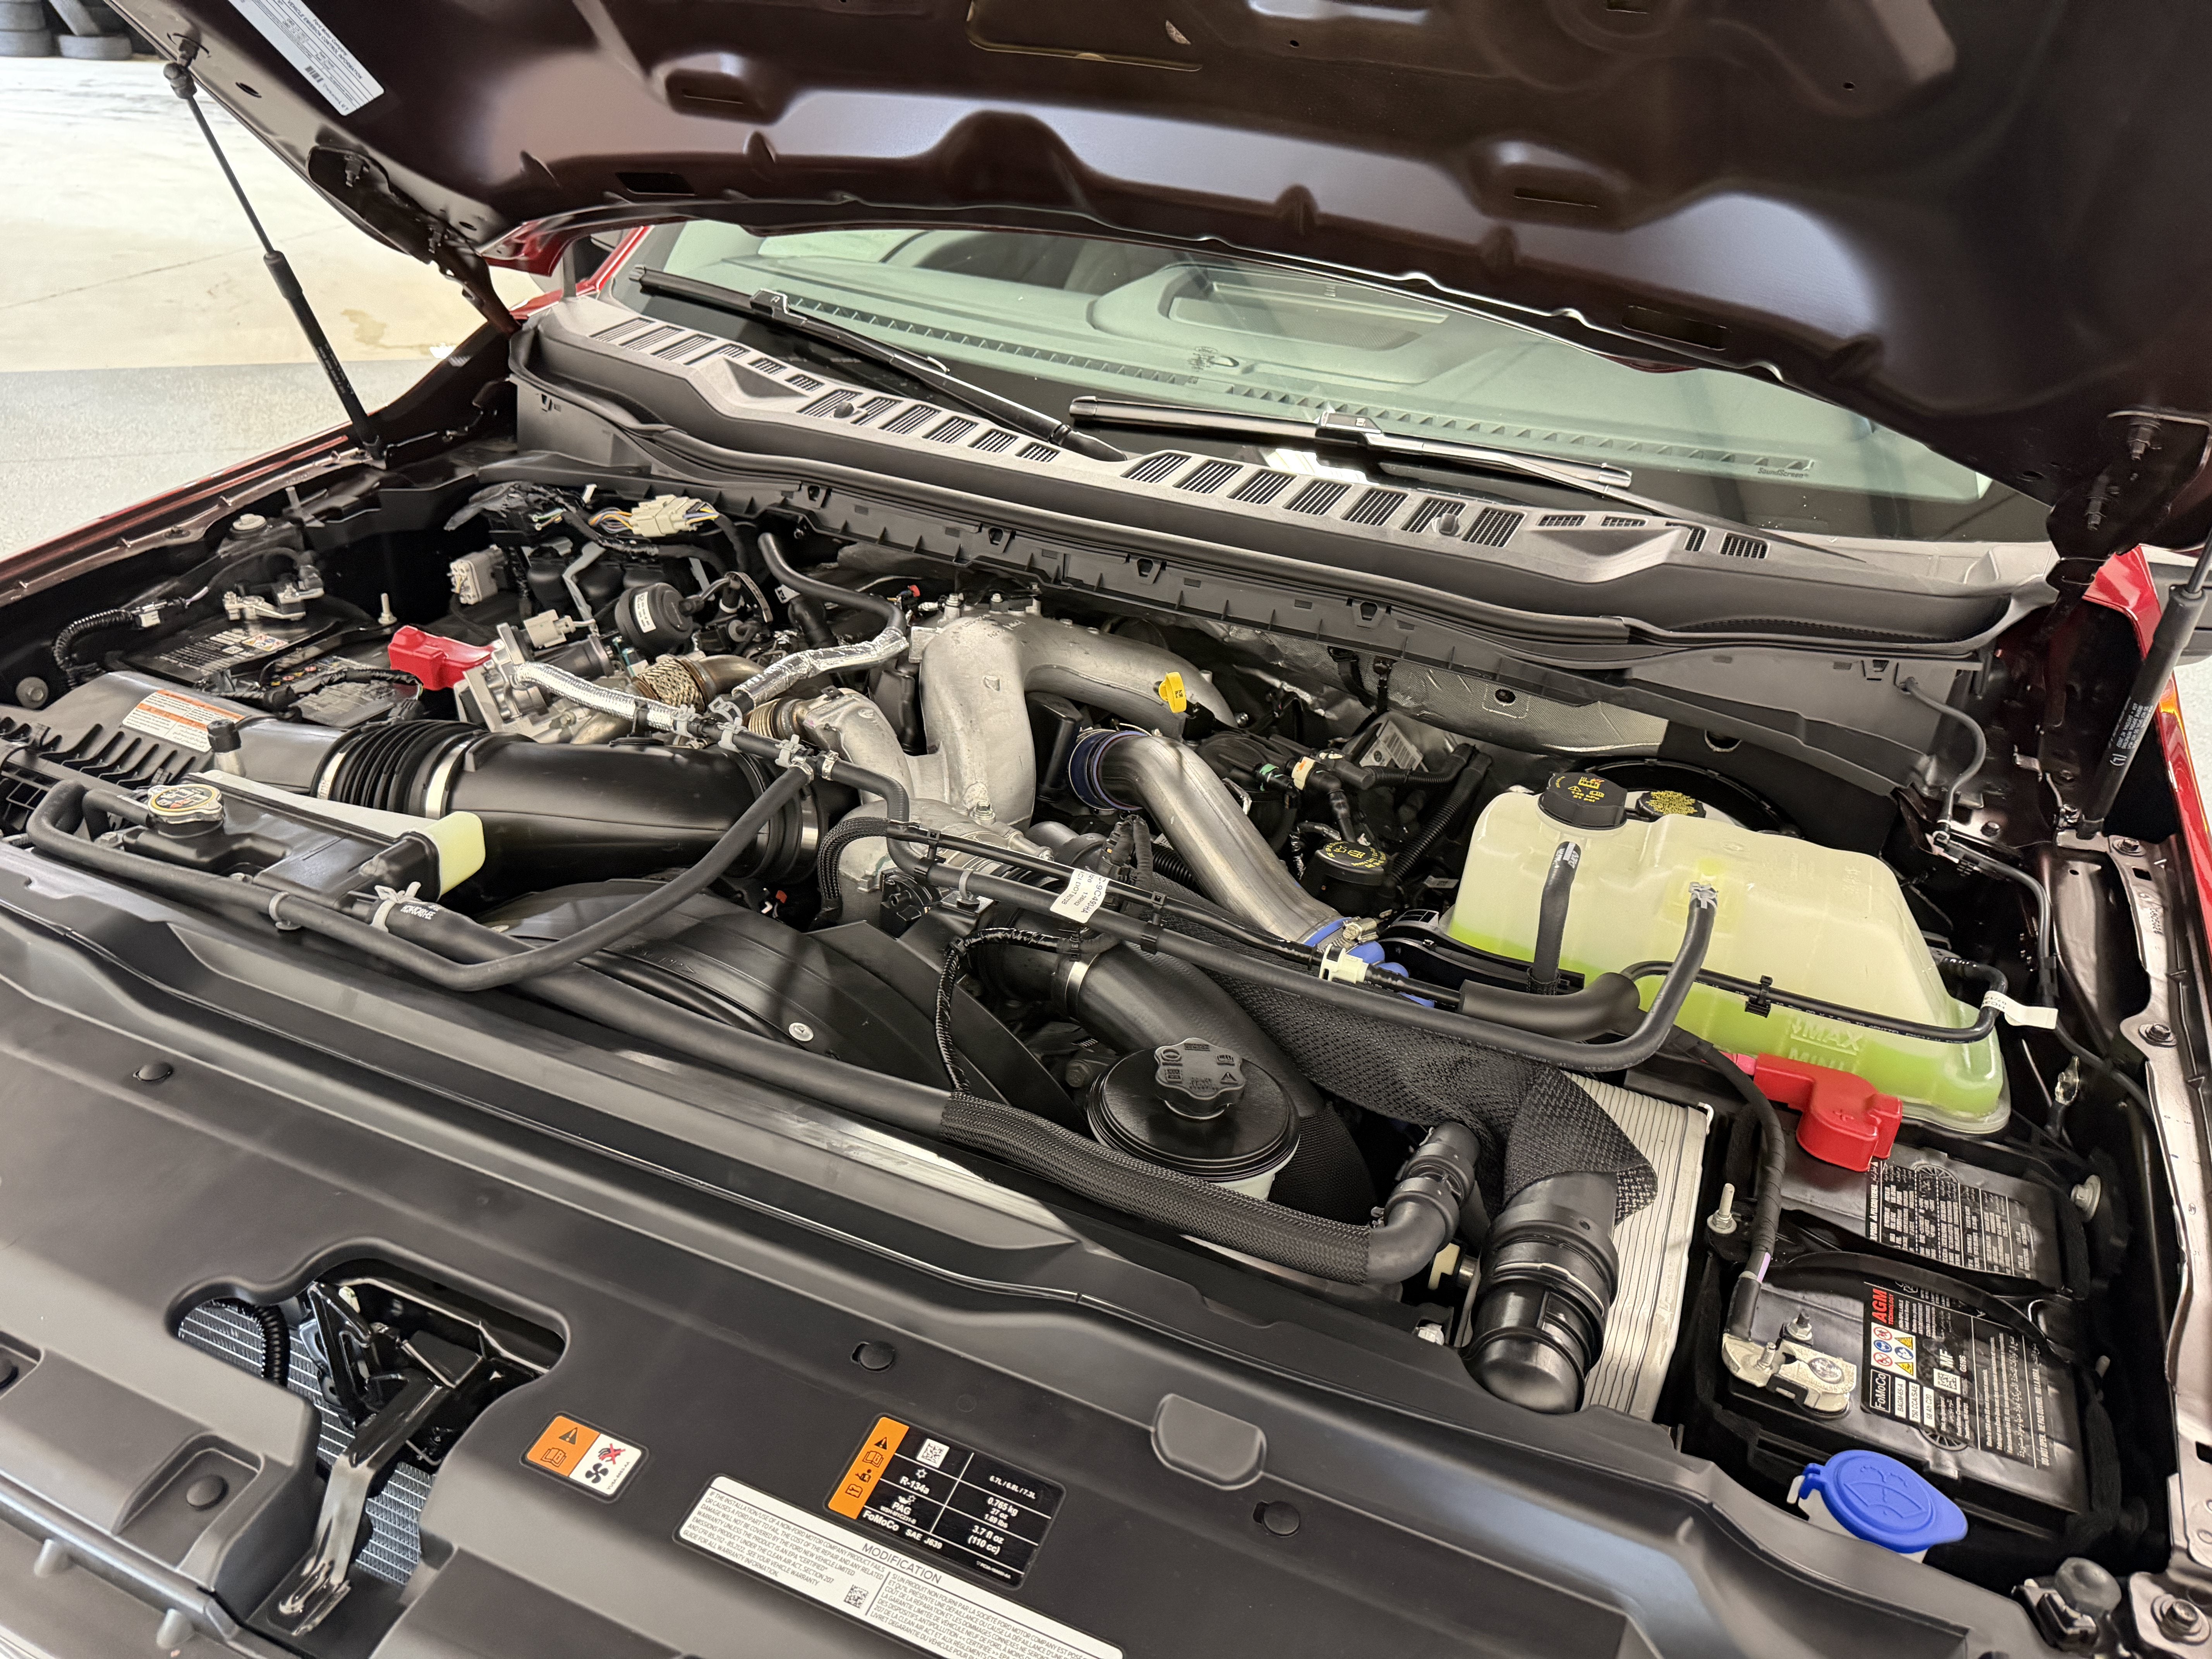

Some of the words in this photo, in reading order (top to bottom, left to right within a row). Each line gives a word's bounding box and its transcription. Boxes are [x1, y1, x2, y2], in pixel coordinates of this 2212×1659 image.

[1871, 1288, 1887, 1324] AGM
[1939, 1348, 1953, 1368] MF
[1874, 1372, 1887, 1410] FoMoCo
[1925, 1405, 1932, 1413] Ah
[899, 1475, 931, 1495] R-134a
[989, 1475, 1004, 1486] 6.7L
[1005, 1481, 1020, 1492] 6.8L
[1022, 1489, 1037, 1499] 7.3L
[891, 1501, 912, 1516] PAG
[983, 1513, 998, 1524] 1.69
[997, 1519, 1009, 1529] lbs
[986, 1496, 1009, 1511] 0.765
[1006, 1504, 1019, 1517] kg
[990, 1507, 1000, 1516] 27
[998, 1512, 1009, 1520] oz
[682, 1528, 699, 1540] GUIDE
[697, 1535, 709, 1545] FOR
[707, 1540, 718, 1549] ALL
[716, 1544, 745, 1561] WARRANTY
[696, 1509, 725, 1526] WARRANTY
[722, 1521, 744, 1535] UNLESS
[742, 1530, 753, 1539] THE
[751, 1534, 776, 1549] PRODUCT
[779, 1547, 789, 1555] AN
[787, 1550, 799, 1560] EPA
[700, 1503, 722, 1517] DAMAGE
[720, 1512, 733, 1522] WILL
[732, 1517, 744, 1527] NOT
[742, 1522, 751, 1530] BE
[749, 1525, 773, 1540] COVERED
[771, 1534, 780, 1543] BY
[778, 1538, 790, 1547] THE
[788, 1542, 804, 1554] FORD
[802, 1548, 816, 1559] NEW
[814, 1554, 836, 1568] VEHICLE
[833, 1563, 856, 1577] LIMITED
[704, 1496, 714, 1505] OR
[711, 1499, 732, 1513] CAUSES
[734, 1510, 750, 1521] FORD
[747, 1515, 762, 1526] PART
[761, 1522, 770, 1530] TO
[780, 1530, 792, 1539] THE
[789, 1534, 805, 1545] COST
[802, 1540, 812, 1548] OF
[810, 1543, 822, 1553] THE
[820, 1548, 840, 1561] REPAIR
[838, 1556, 851, 1566] AND
[849, 1561, 862, 1571] ANY
[860, 1566, 884, 1581] RELATED
[714, 1492, 725, 1501] THE
[723, 1496, 769, 1521] INSTALLATION/USE
[768, 1516, 776, 1524] OF
[779, 1521, 806, 1538] NON-FORD
[804, 1532, 824, 1546] MOTOR
[822, 1540, 848, 1556] COMPANY
[846, 1551, 871, 1566] PRODUCT
[869, 1561, 886, 1573] FAILS
[862, 1510, 900, 1532] FoMoCo
[904, 1528, 923, 1541] SAE
[923, 1536, 943, 1550] J639
[967, 1534, 988, 1550] (110
[985, 1542, 1001, 1556] cc)
[972, 1524, 987, 1537] 3.7
[985, 1530, 994, 1540] fl
[992, 1534, 1005, 1545] oz
[687, 1522, 700, 1532] AND
[697, 1527, 709, 1536] CFR
[745, 1549, 757, 1558] SEE
[756, 1553, 771, 1565] YOUR
[769, 1559, 791, 1573] VEHICLE
[789, 1568, 820, 1587] WARRANTY
[691, 1516, 719, 1532] EMISSIONS
[716, 1527, 741, 1542] PRODUCT
[738, 1537, 758, 1550] UNDER
[756, 1545, 768, 1554] THE
[765, 1549, 784, 1562] CLEAN
[781, 1556, 793, 1566] AIR
[801, 1565, 825, 1580] SECTION
[823, 1575, 835, 1585] 207
[861, 1542, 943, 1585] MODIFICATION
